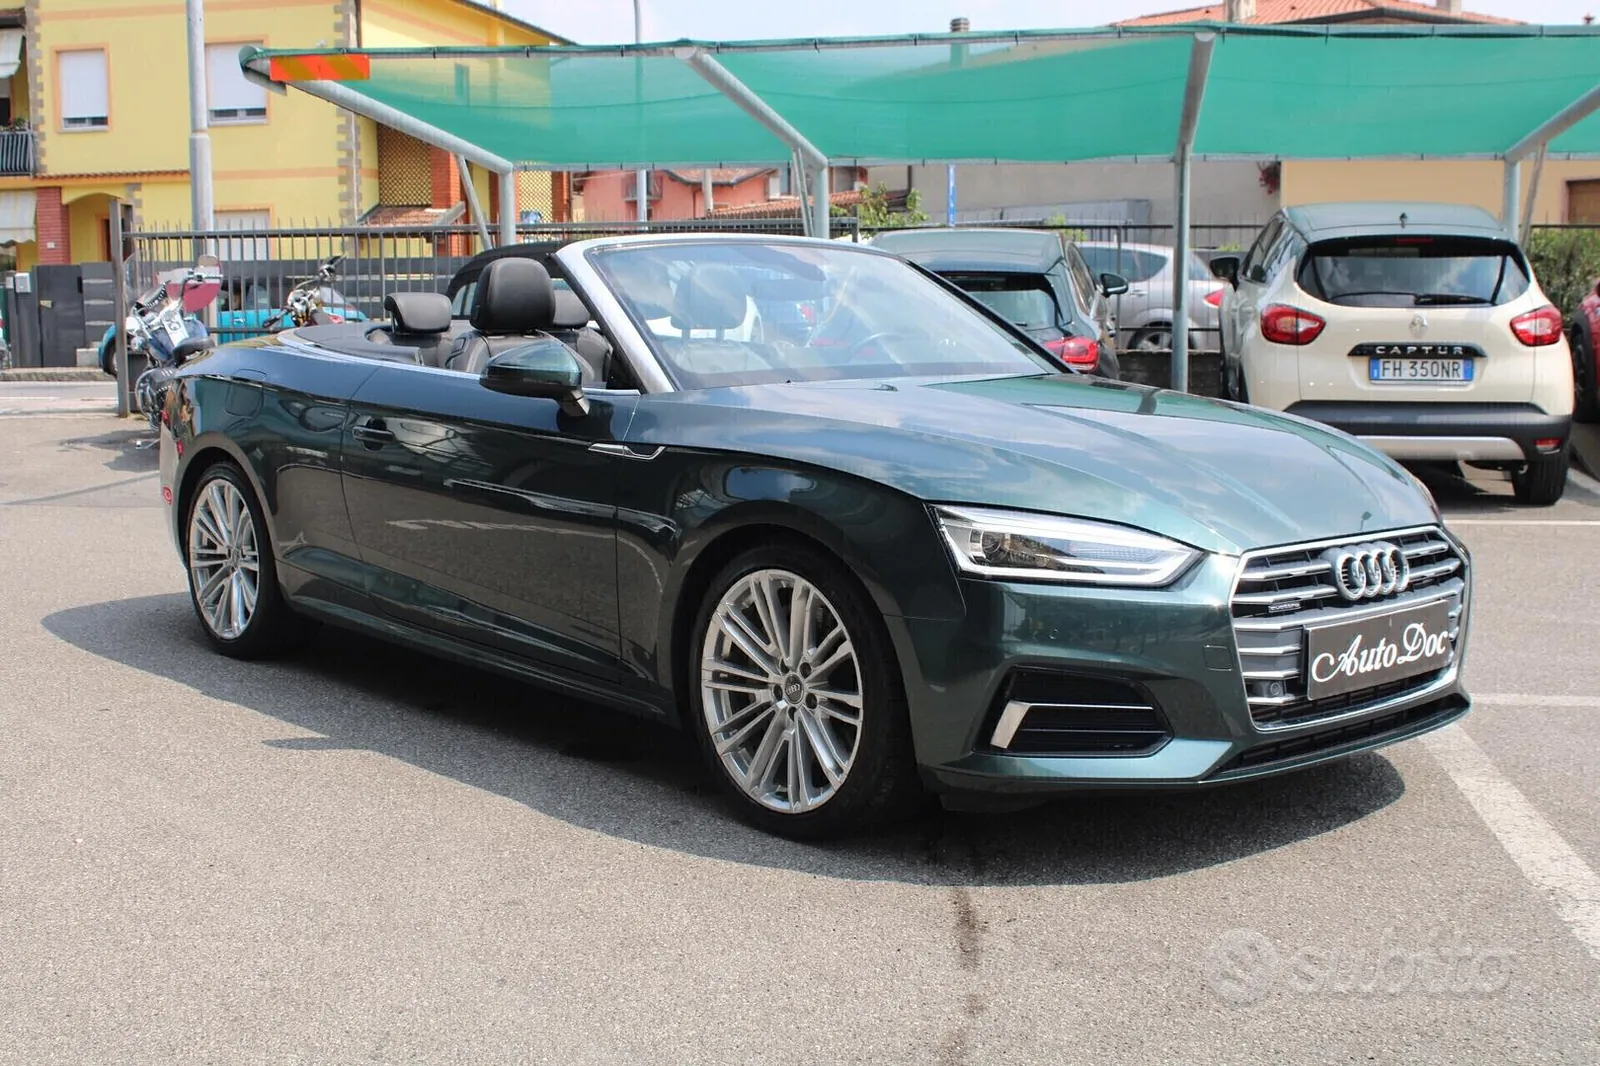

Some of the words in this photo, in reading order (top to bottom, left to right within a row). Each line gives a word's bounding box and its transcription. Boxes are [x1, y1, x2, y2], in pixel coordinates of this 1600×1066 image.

[1375, 346, 1463, 354] CAPTUR
[1381, 360, 1402, 378] FH
[1409, 360, 1461, 378] 350NR
